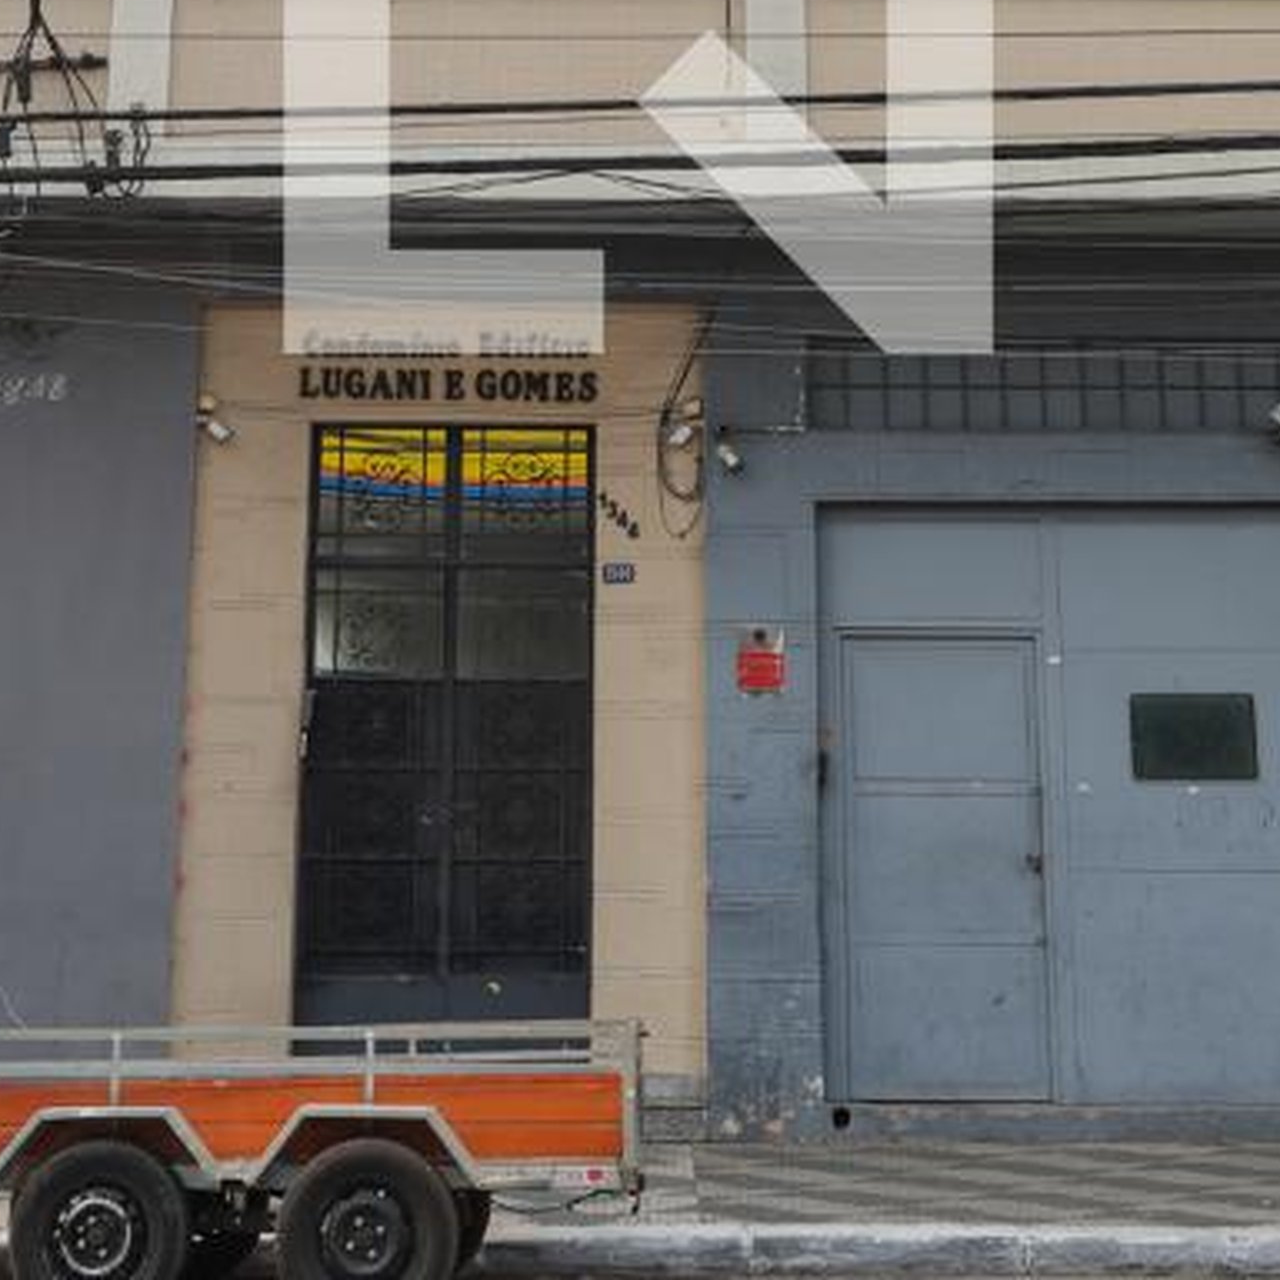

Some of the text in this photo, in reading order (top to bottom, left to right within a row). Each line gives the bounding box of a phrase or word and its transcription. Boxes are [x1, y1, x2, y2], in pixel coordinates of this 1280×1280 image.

[298, 365, 599, 403] LUGANI E GOMES
